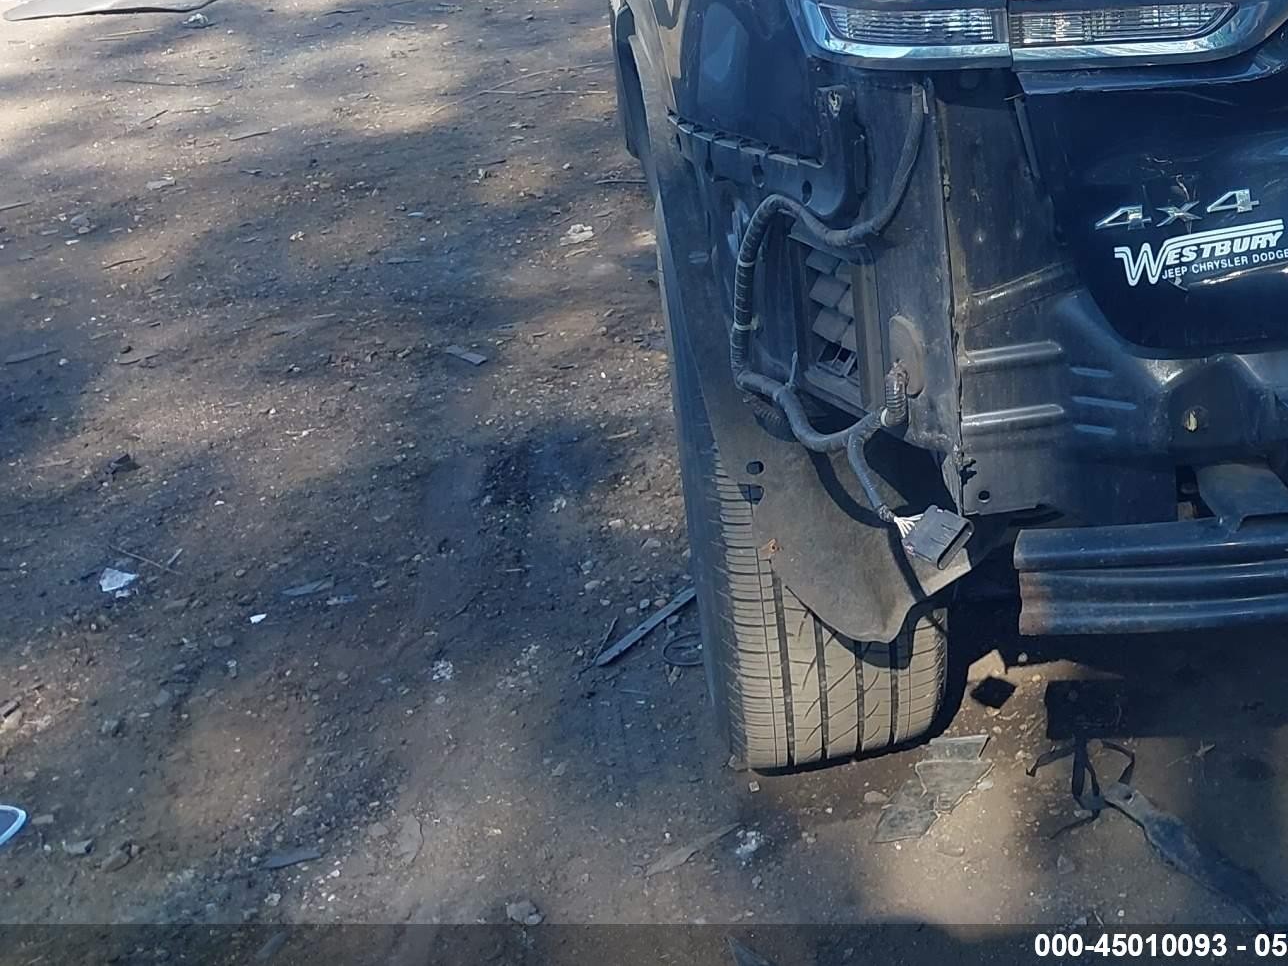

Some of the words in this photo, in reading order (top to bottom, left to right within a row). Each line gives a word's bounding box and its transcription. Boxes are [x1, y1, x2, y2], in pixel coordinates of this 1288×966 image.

[1114, 220, 1284, 286] WESTBURY
[1162, 266, 1188, 279] JEEP
[1191, 257, 1249, 274] CHRYSLER
